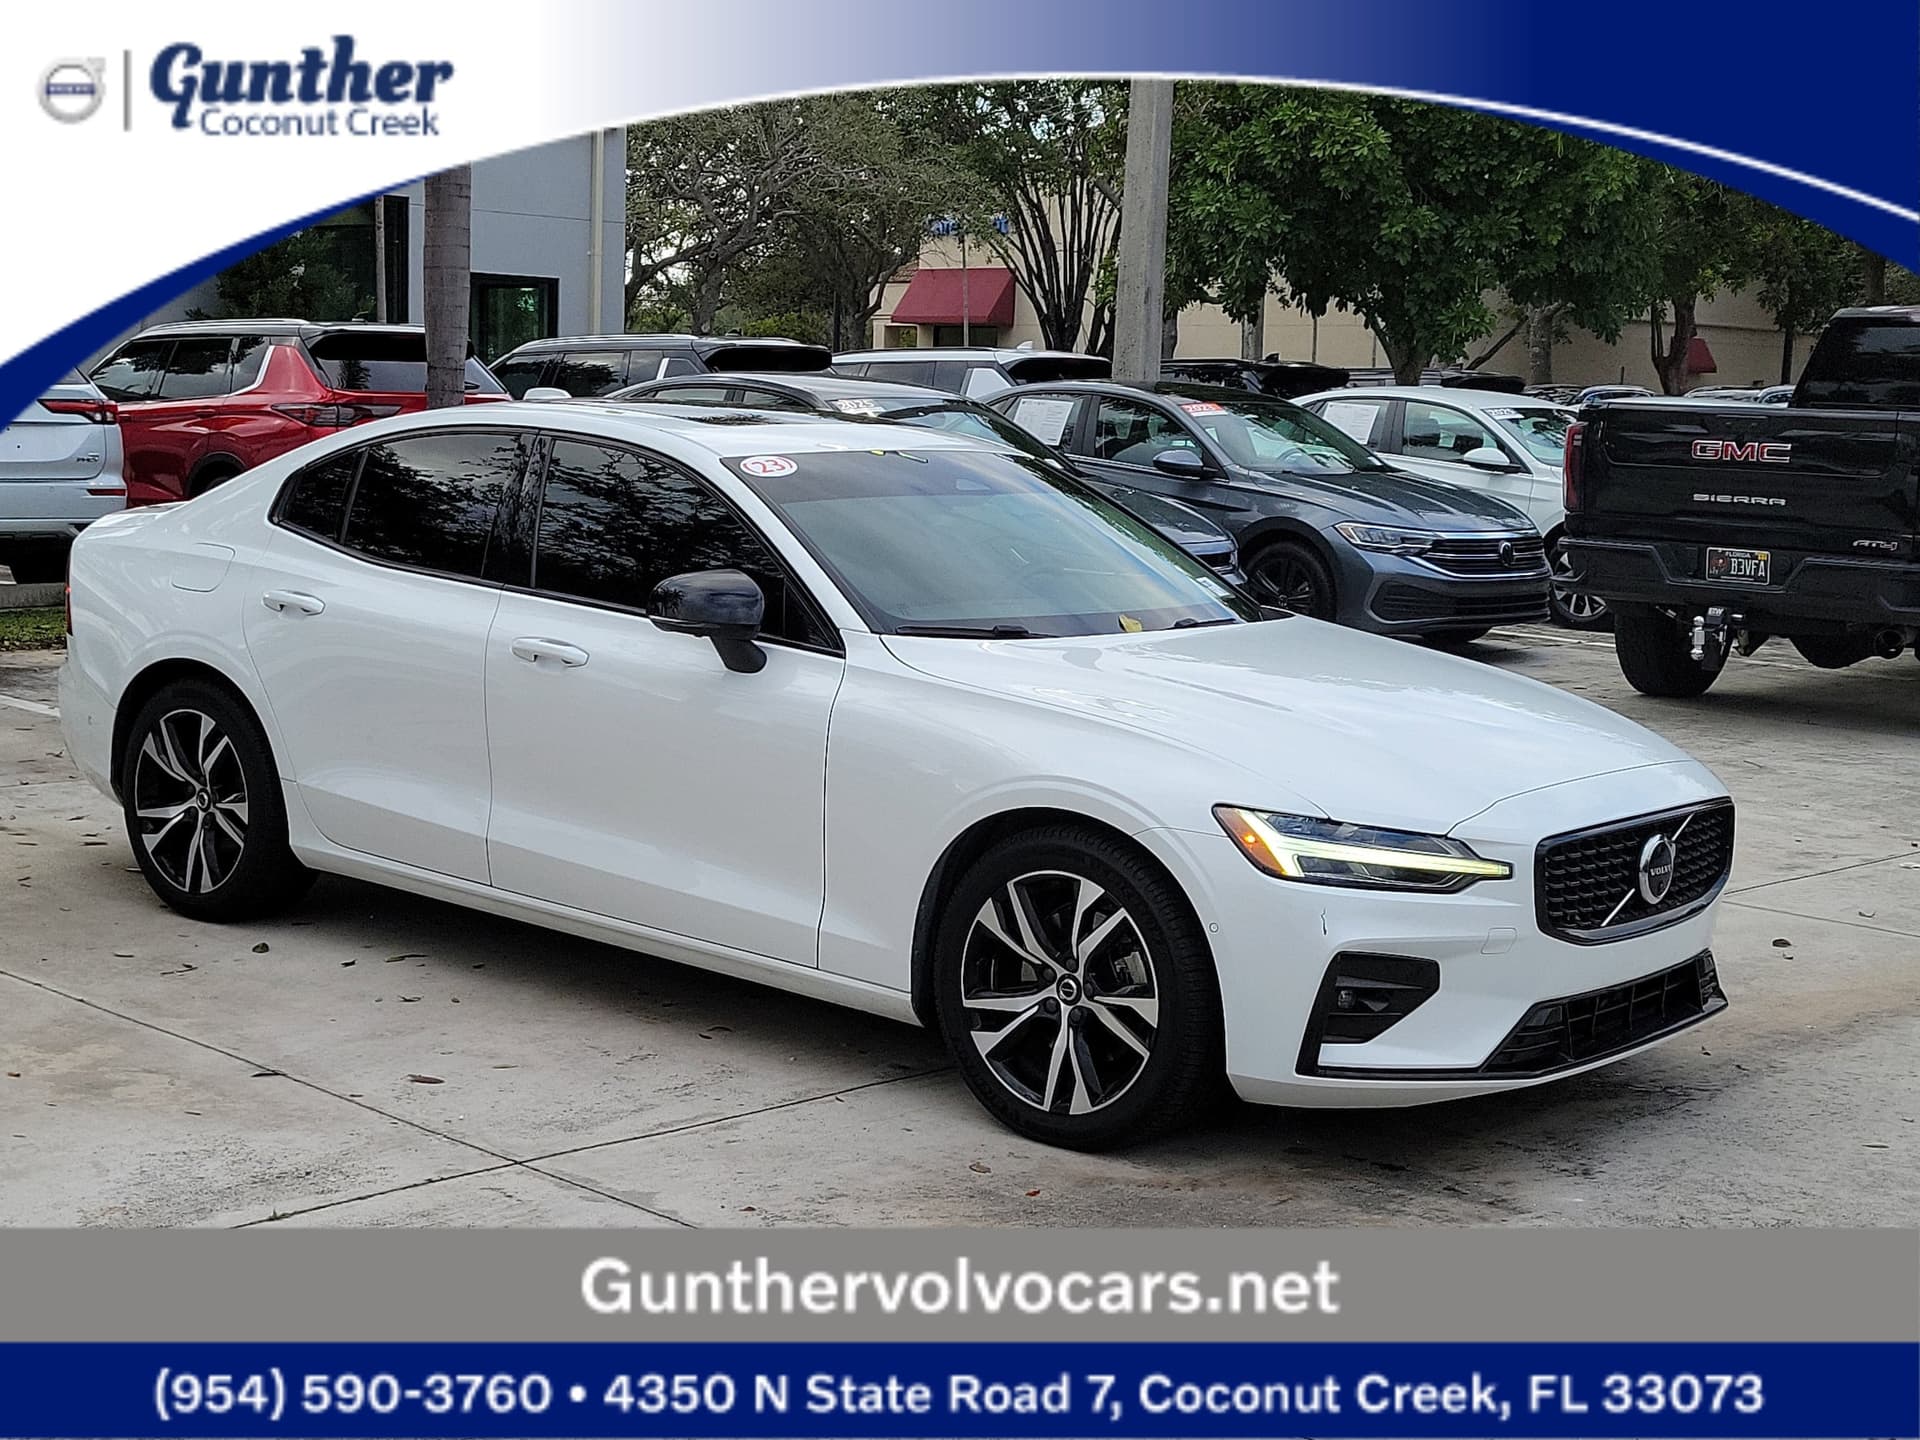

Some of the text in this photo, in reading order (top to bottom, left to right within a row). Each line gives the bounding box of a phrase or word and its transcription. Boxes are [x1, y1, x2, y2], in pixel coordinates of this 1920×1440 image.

[1692, 440, 1792, 463] GMC
[751, 460, 785, 473] 23
[1693, 494, 1786, 506] SIERRA
[1853, 540, 1898, 551] AT4
